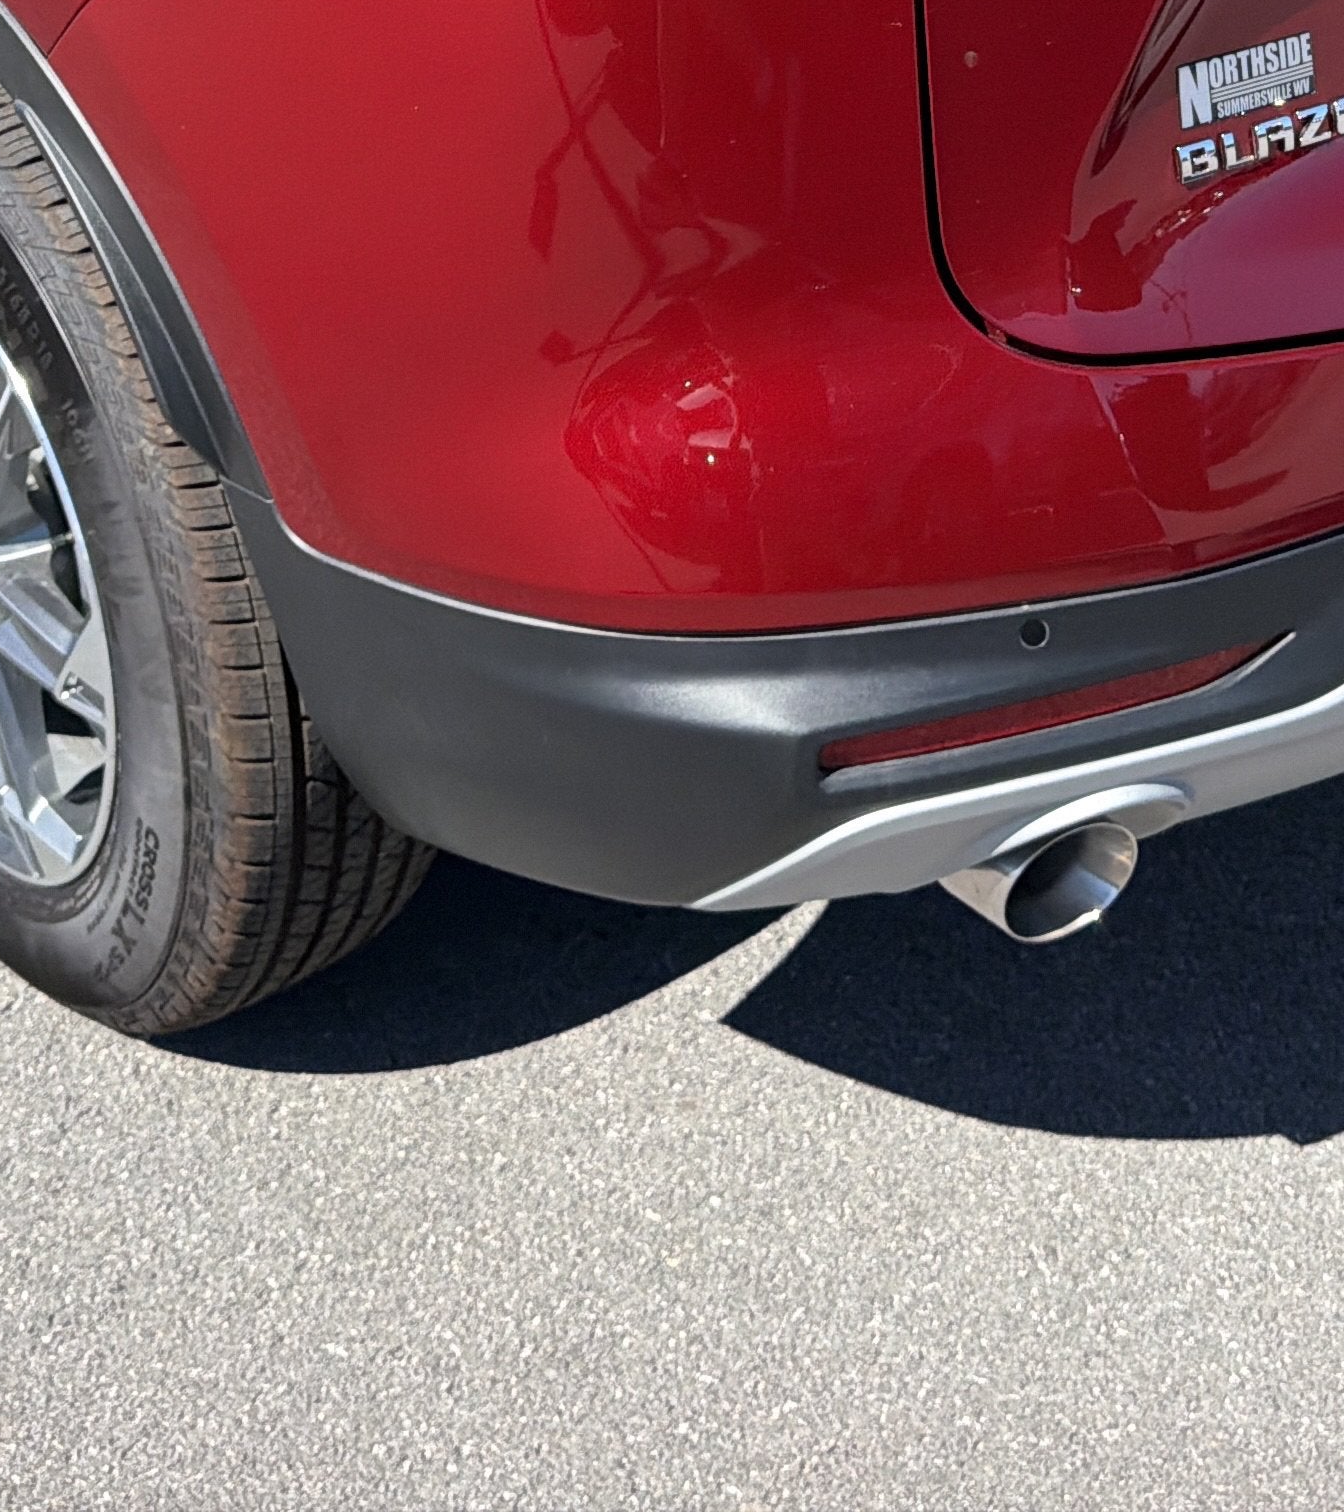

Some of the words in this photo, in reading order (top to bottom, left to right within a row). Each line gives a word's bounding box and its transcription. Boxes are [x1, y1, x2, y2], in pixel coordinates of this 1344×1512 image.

[1178, 31, 1313, 129] NORTHSIDE
[1217, 82, 1293, 119] SUMMERSVILLE
[1292, 76, 1312, 98] WV
[135, 825, 160, 912] CROSS
